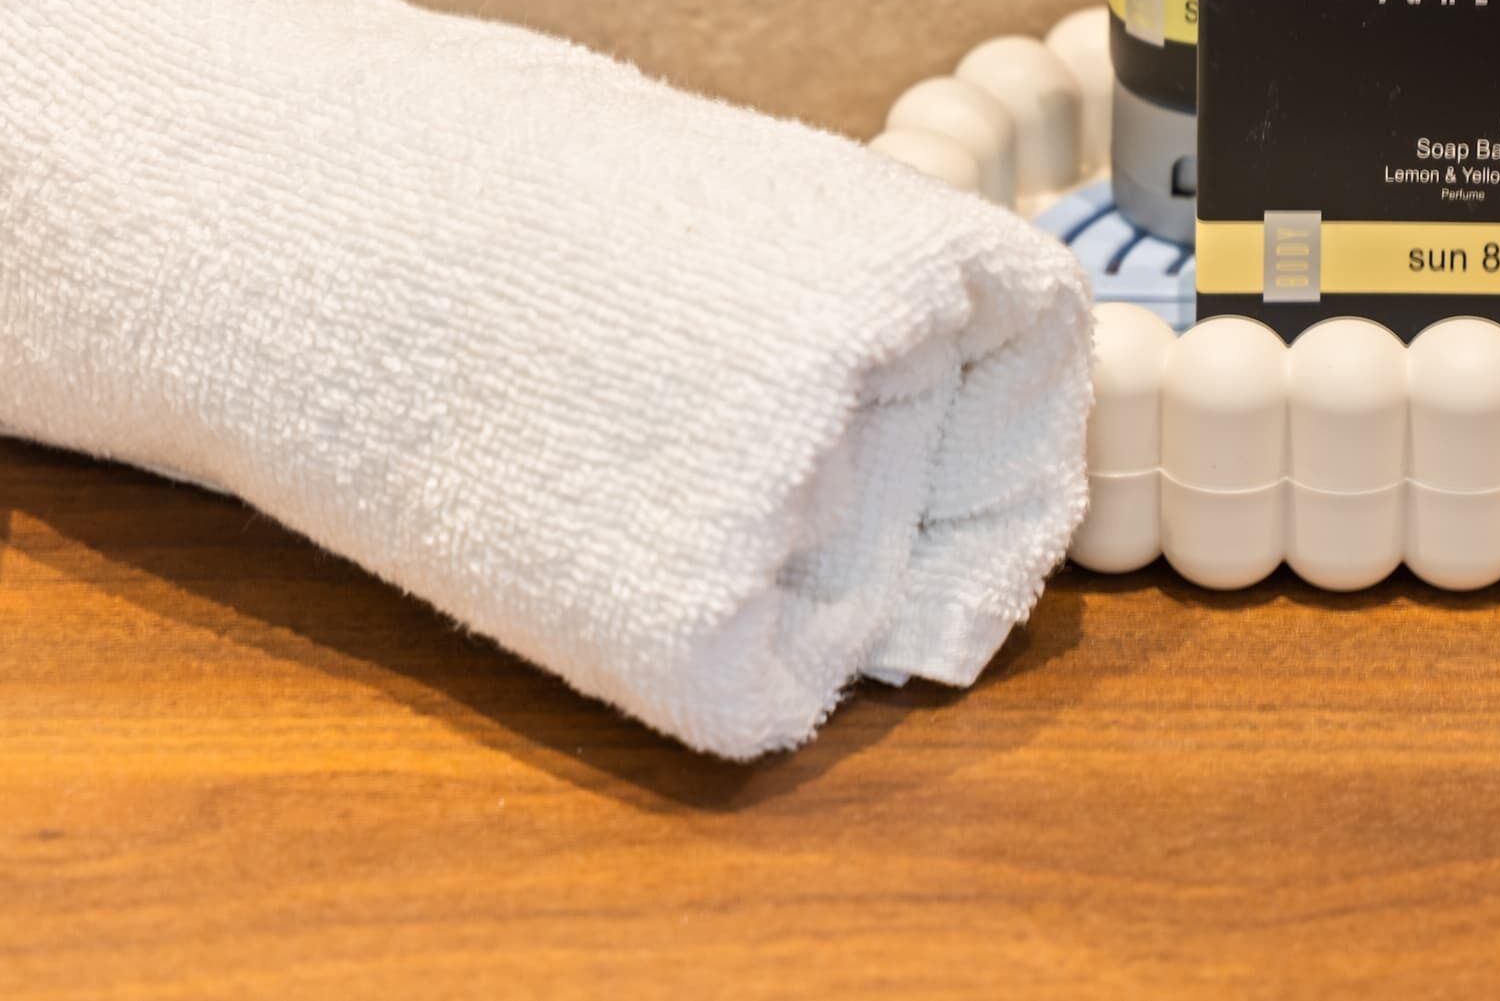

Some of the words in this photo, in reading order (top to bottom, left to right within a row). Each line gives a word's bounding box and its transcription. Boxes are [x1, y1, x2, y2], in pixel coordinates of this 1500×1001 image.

[1416, 137, 1470, 164] Soap
[1385, 165, 1440, 183] Lemon
[1445, 166, 1457, 184] &
[1441, 187, 1486, 201] Perfume
[1408, 248, 1468, 273] sun
